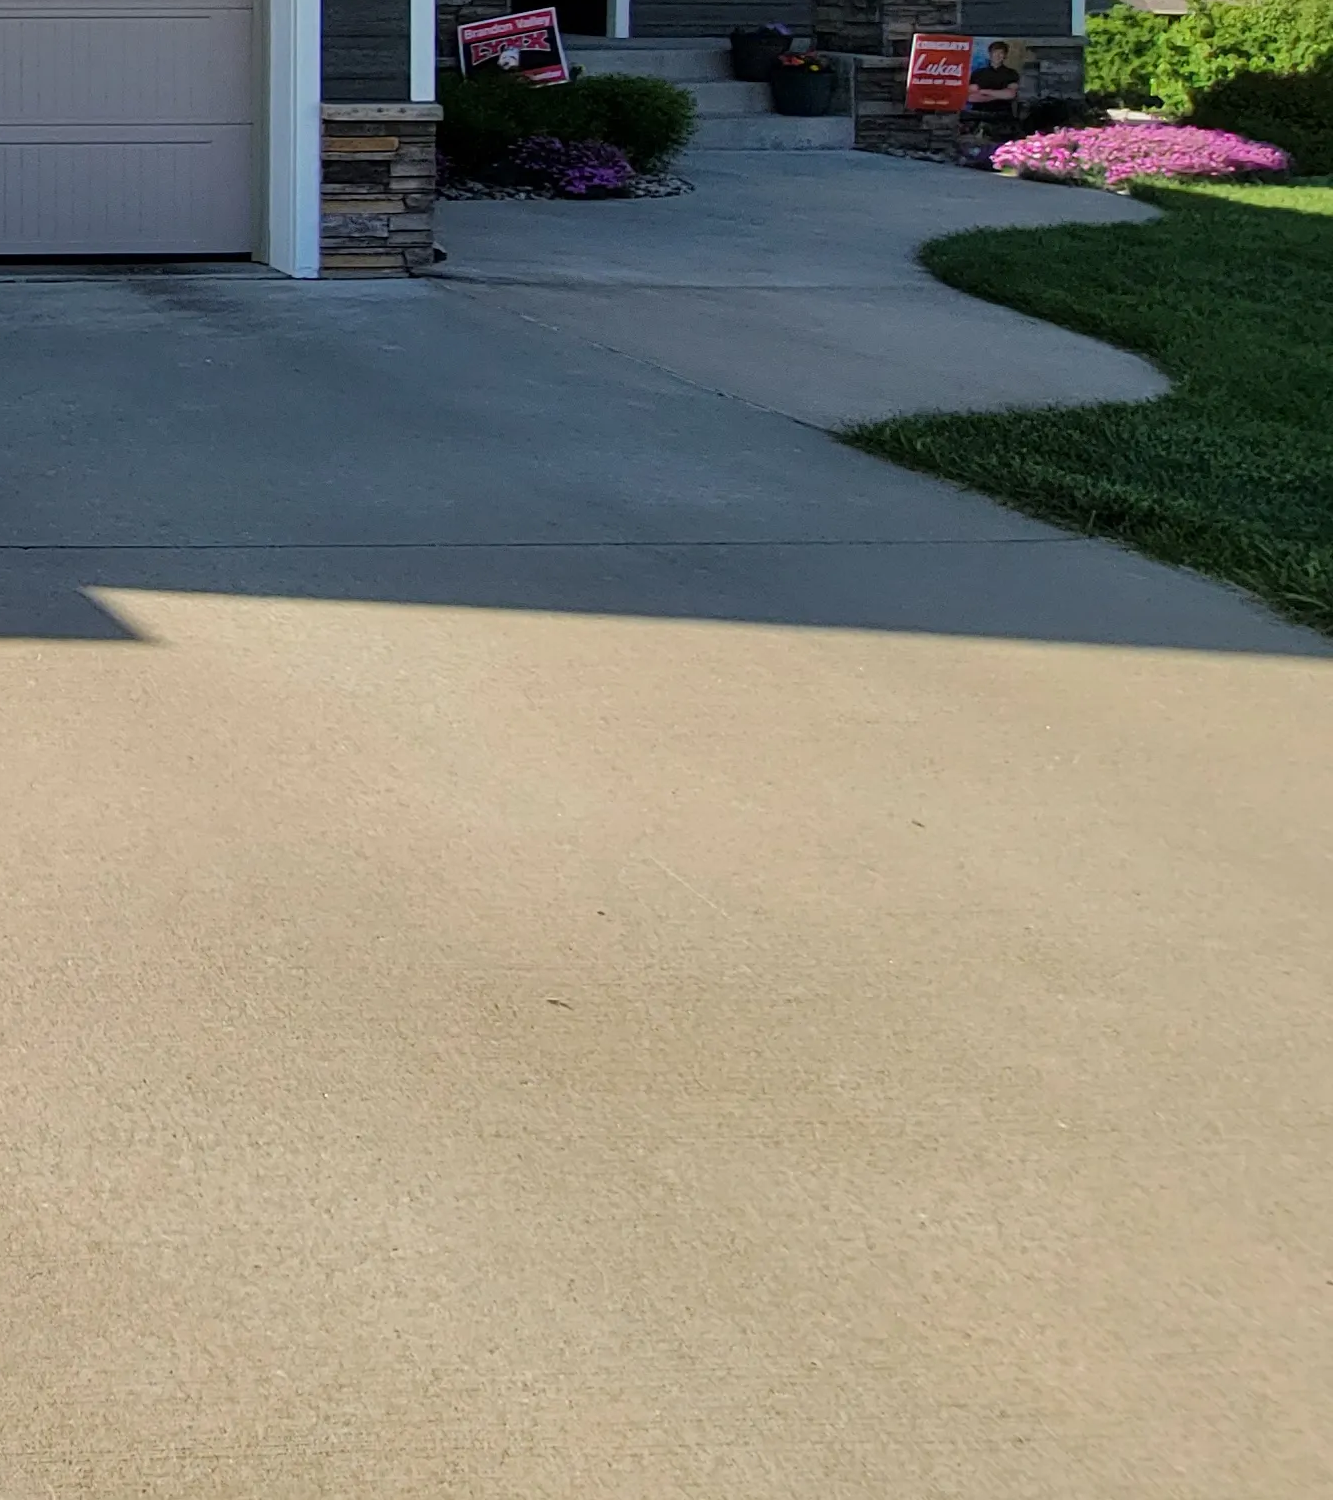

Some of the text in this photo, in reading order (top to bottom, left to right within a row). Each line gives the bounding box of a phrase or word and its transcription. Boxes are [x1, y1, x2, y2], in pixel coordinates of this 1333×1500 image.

[464, 15, 550, 40] Brandon Valley
[913, 53, 963, 77] Lukas
